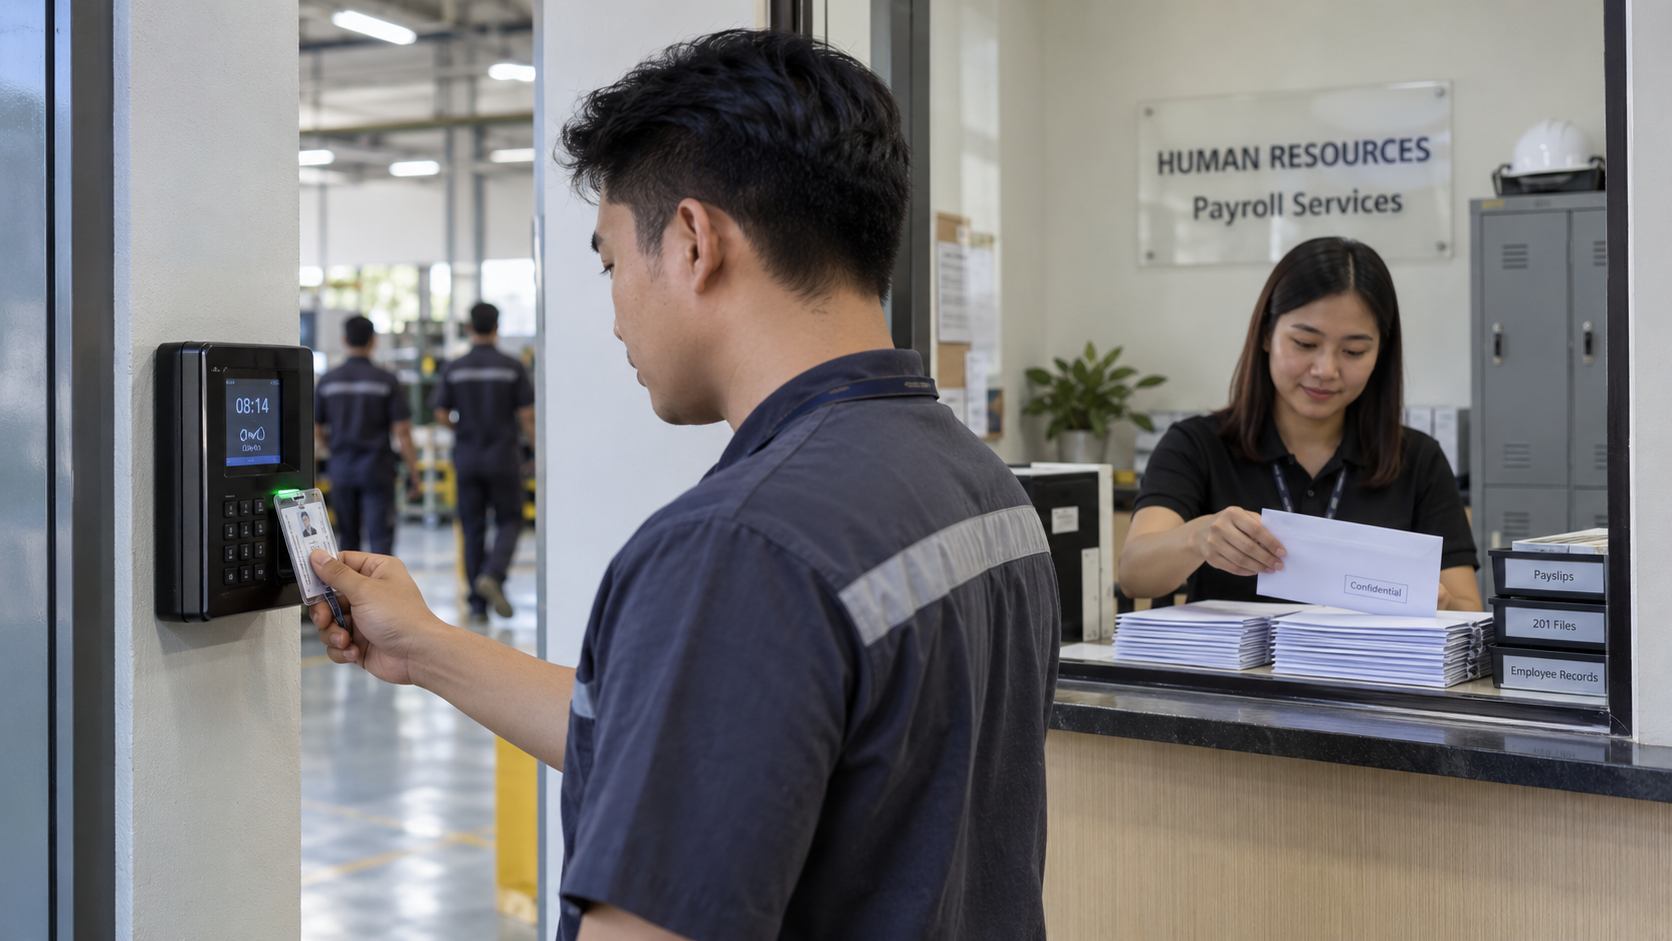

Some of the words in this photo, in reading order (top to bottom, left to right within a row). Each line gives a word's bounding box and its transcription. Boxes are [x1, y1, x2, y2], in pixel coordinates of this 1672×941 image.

[1157, 146, 1260, 175] HUMAN
[1269, 136, 1432, 170] RESOURCES
[1193, 192, 1284, 226] Payroll
[1292, 188, 1404, 217] Services
[235, 397, 270, 414] 08:14
[1533, 569, 1575, 583] Payslips
[1350, 581, 1402, 597] Confidential
[1532, 618, 1551, 629] 201
[1553, 620, 1577, 632] Files
[1510, 665, 1557, 680] Employee
[1559, 670, 1599, 683] Records
